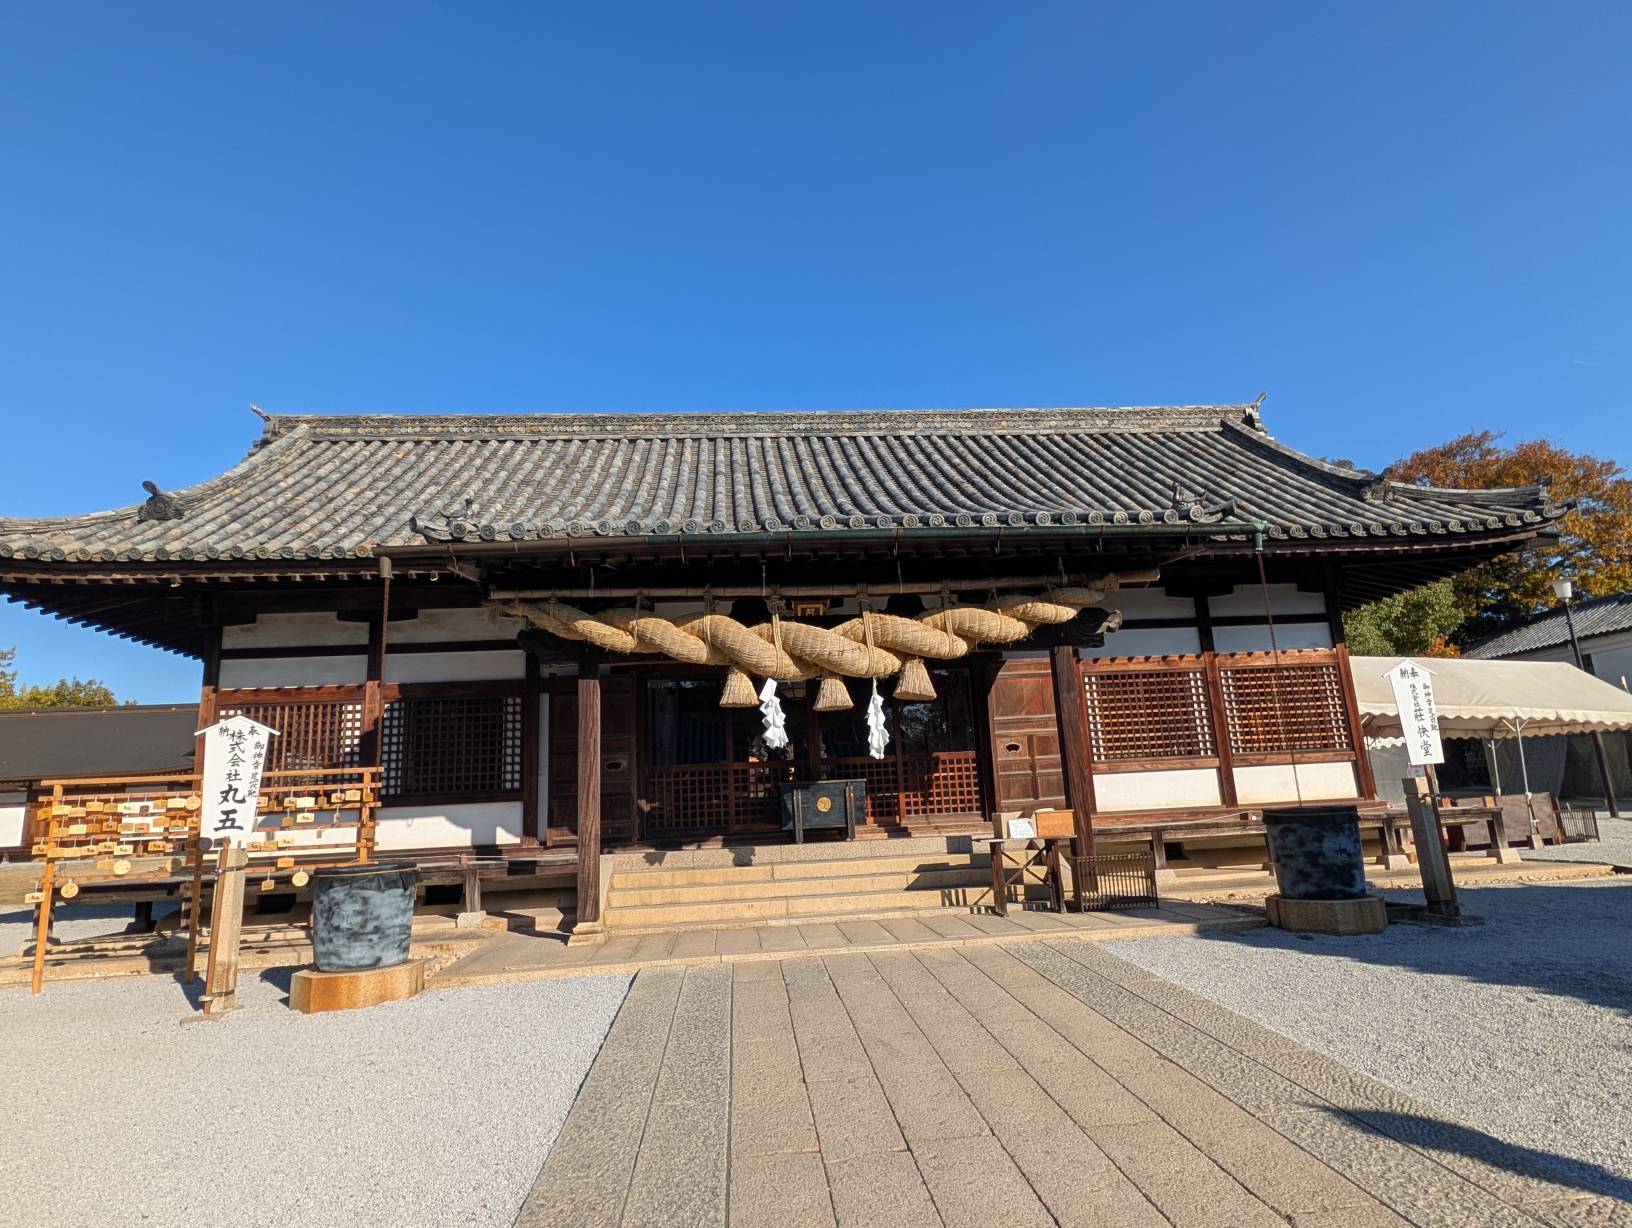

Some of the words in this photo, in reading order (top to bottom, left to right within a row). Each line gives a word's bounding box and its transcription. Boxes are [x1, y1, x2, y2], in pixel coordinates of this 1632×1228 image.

[213, 729, 248, 833] 株式会社丸五
